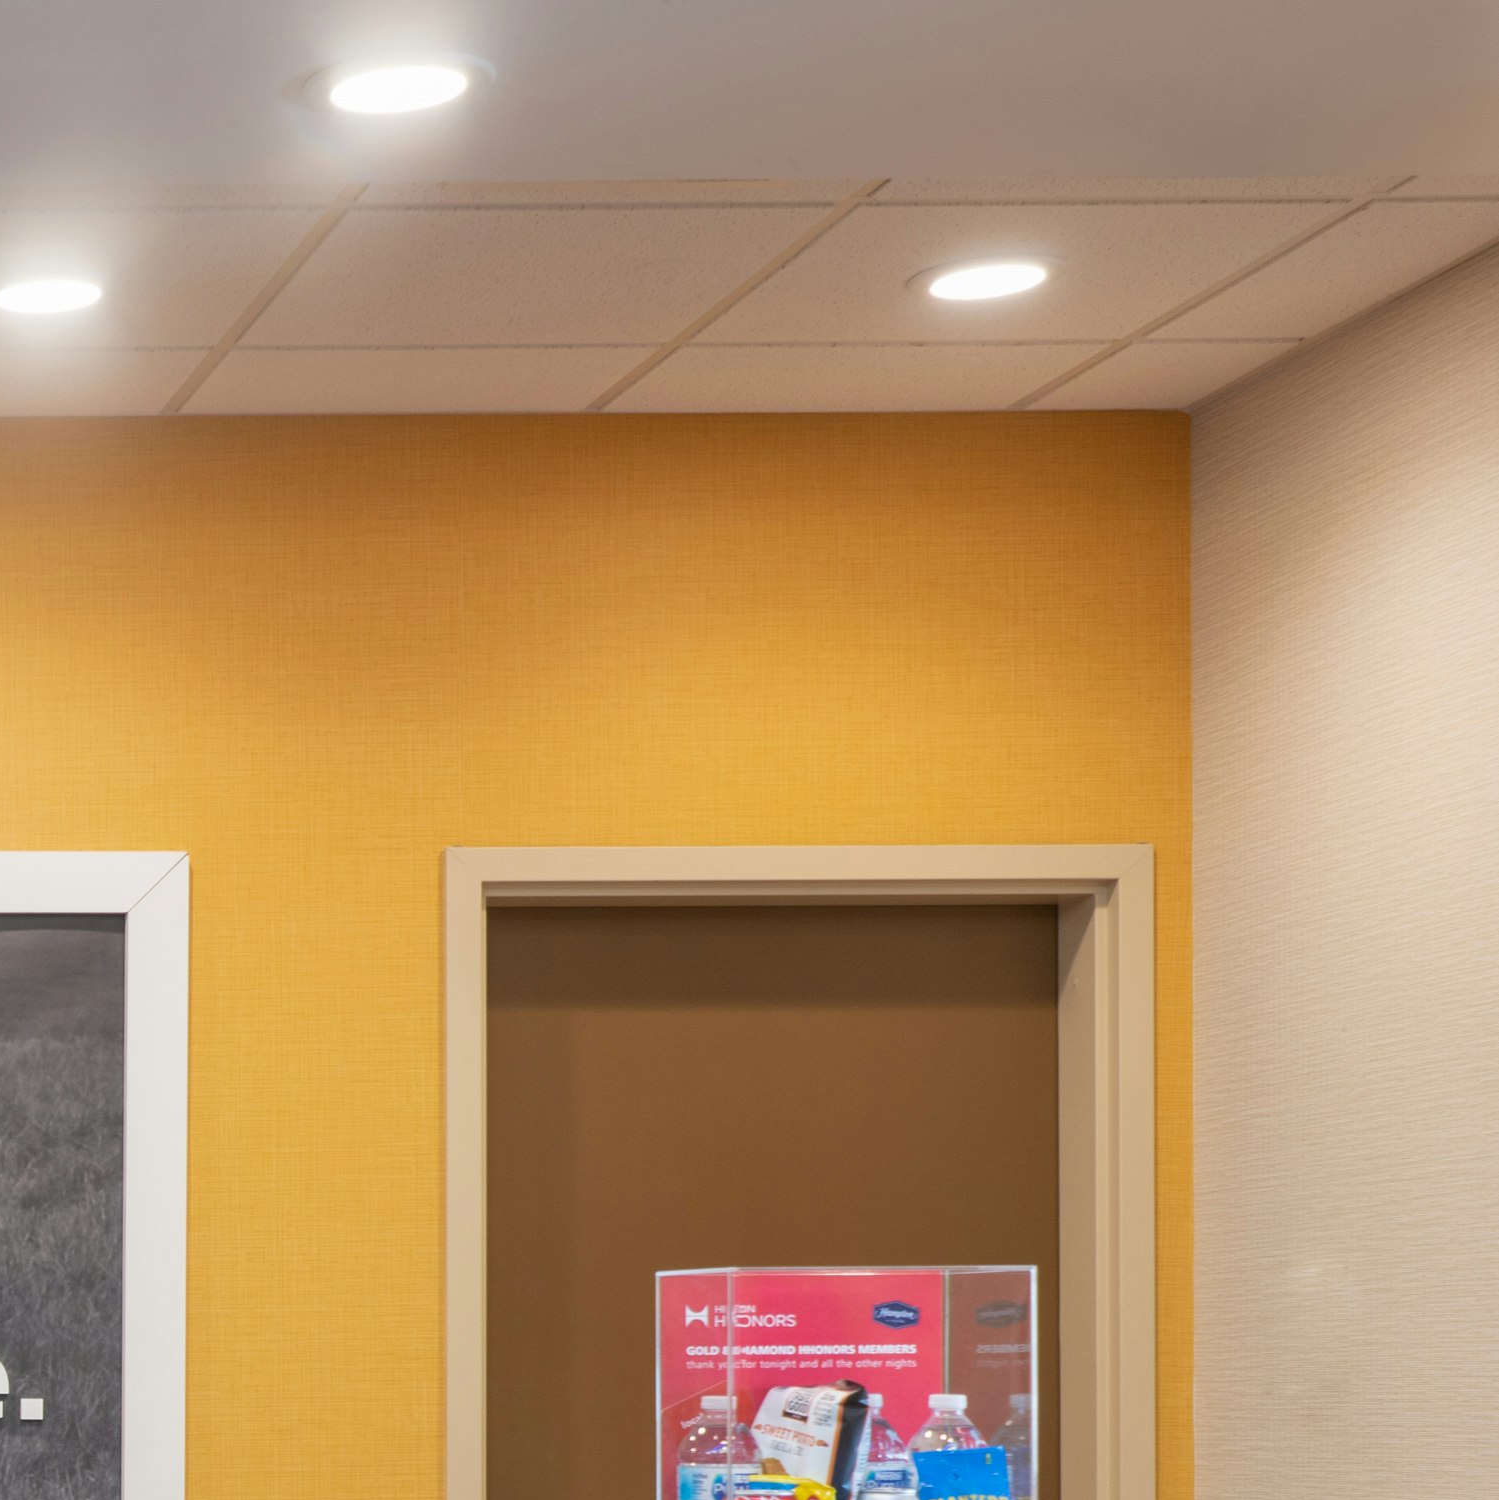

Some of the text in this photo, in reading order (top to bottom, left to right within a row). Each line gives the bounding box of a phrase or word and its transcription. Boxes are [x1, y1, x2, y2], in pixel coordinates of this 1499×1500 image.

[686, 1345, 720, 1356] GOLD
[798, 1344, 856, 1355] HHONORS
[858, 1344, 918, 1354] MEMBERS
[686, 1360, 714, 1370] thank
[760, 1359, 797, 1371] tonight
[799, 1359, 819, 1369] and
[821, 1359, 833, 1368] all
[836, 1359, 853, 1368] the
[855, 1359, 882, 1368] other
[885, 1358, 917, 1370] nights
